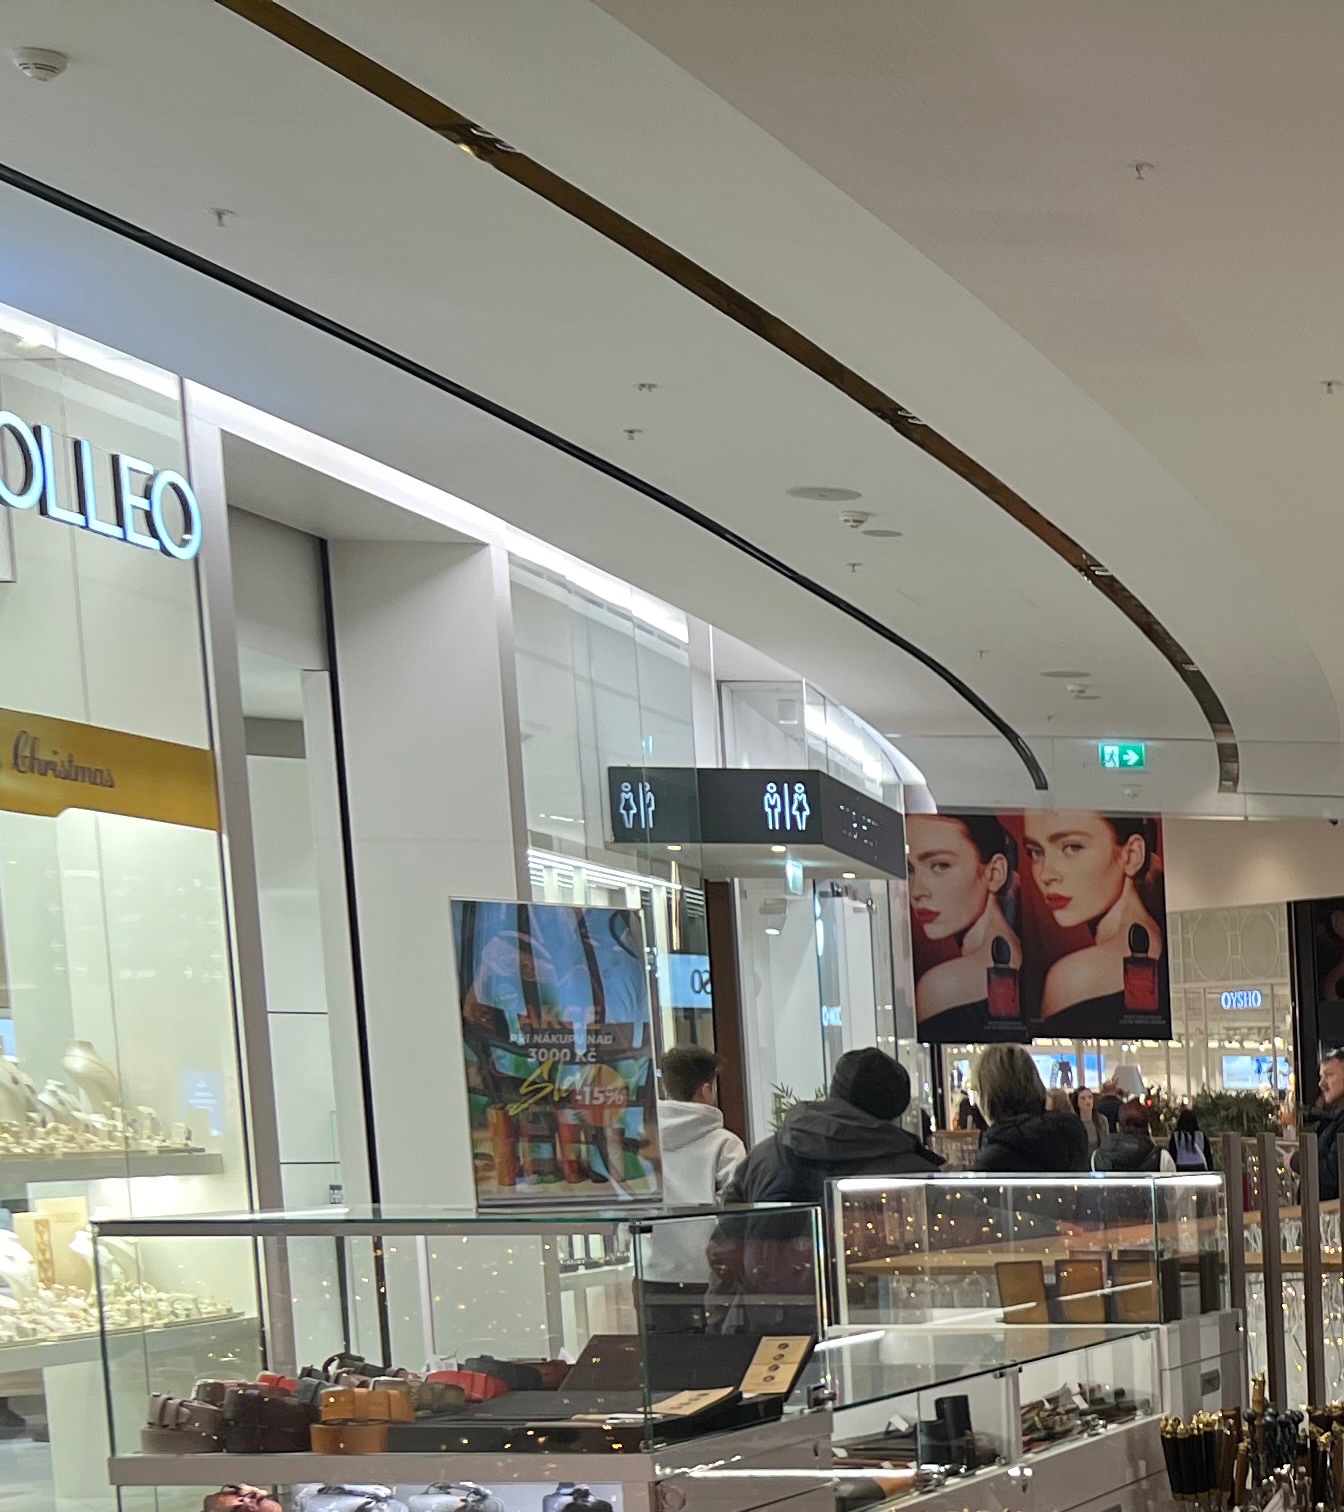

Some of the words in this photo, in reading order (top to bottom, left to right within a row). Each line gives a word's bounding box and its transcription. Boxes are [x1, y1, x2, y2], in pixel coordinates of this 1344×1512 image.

[13, 730, 116, 788] Christmas
[1221, 990, 1262, 1009] OYSHO
[588, 1034, 613, 1045] NAD
[527, 1048, 571, 1062] 3000
